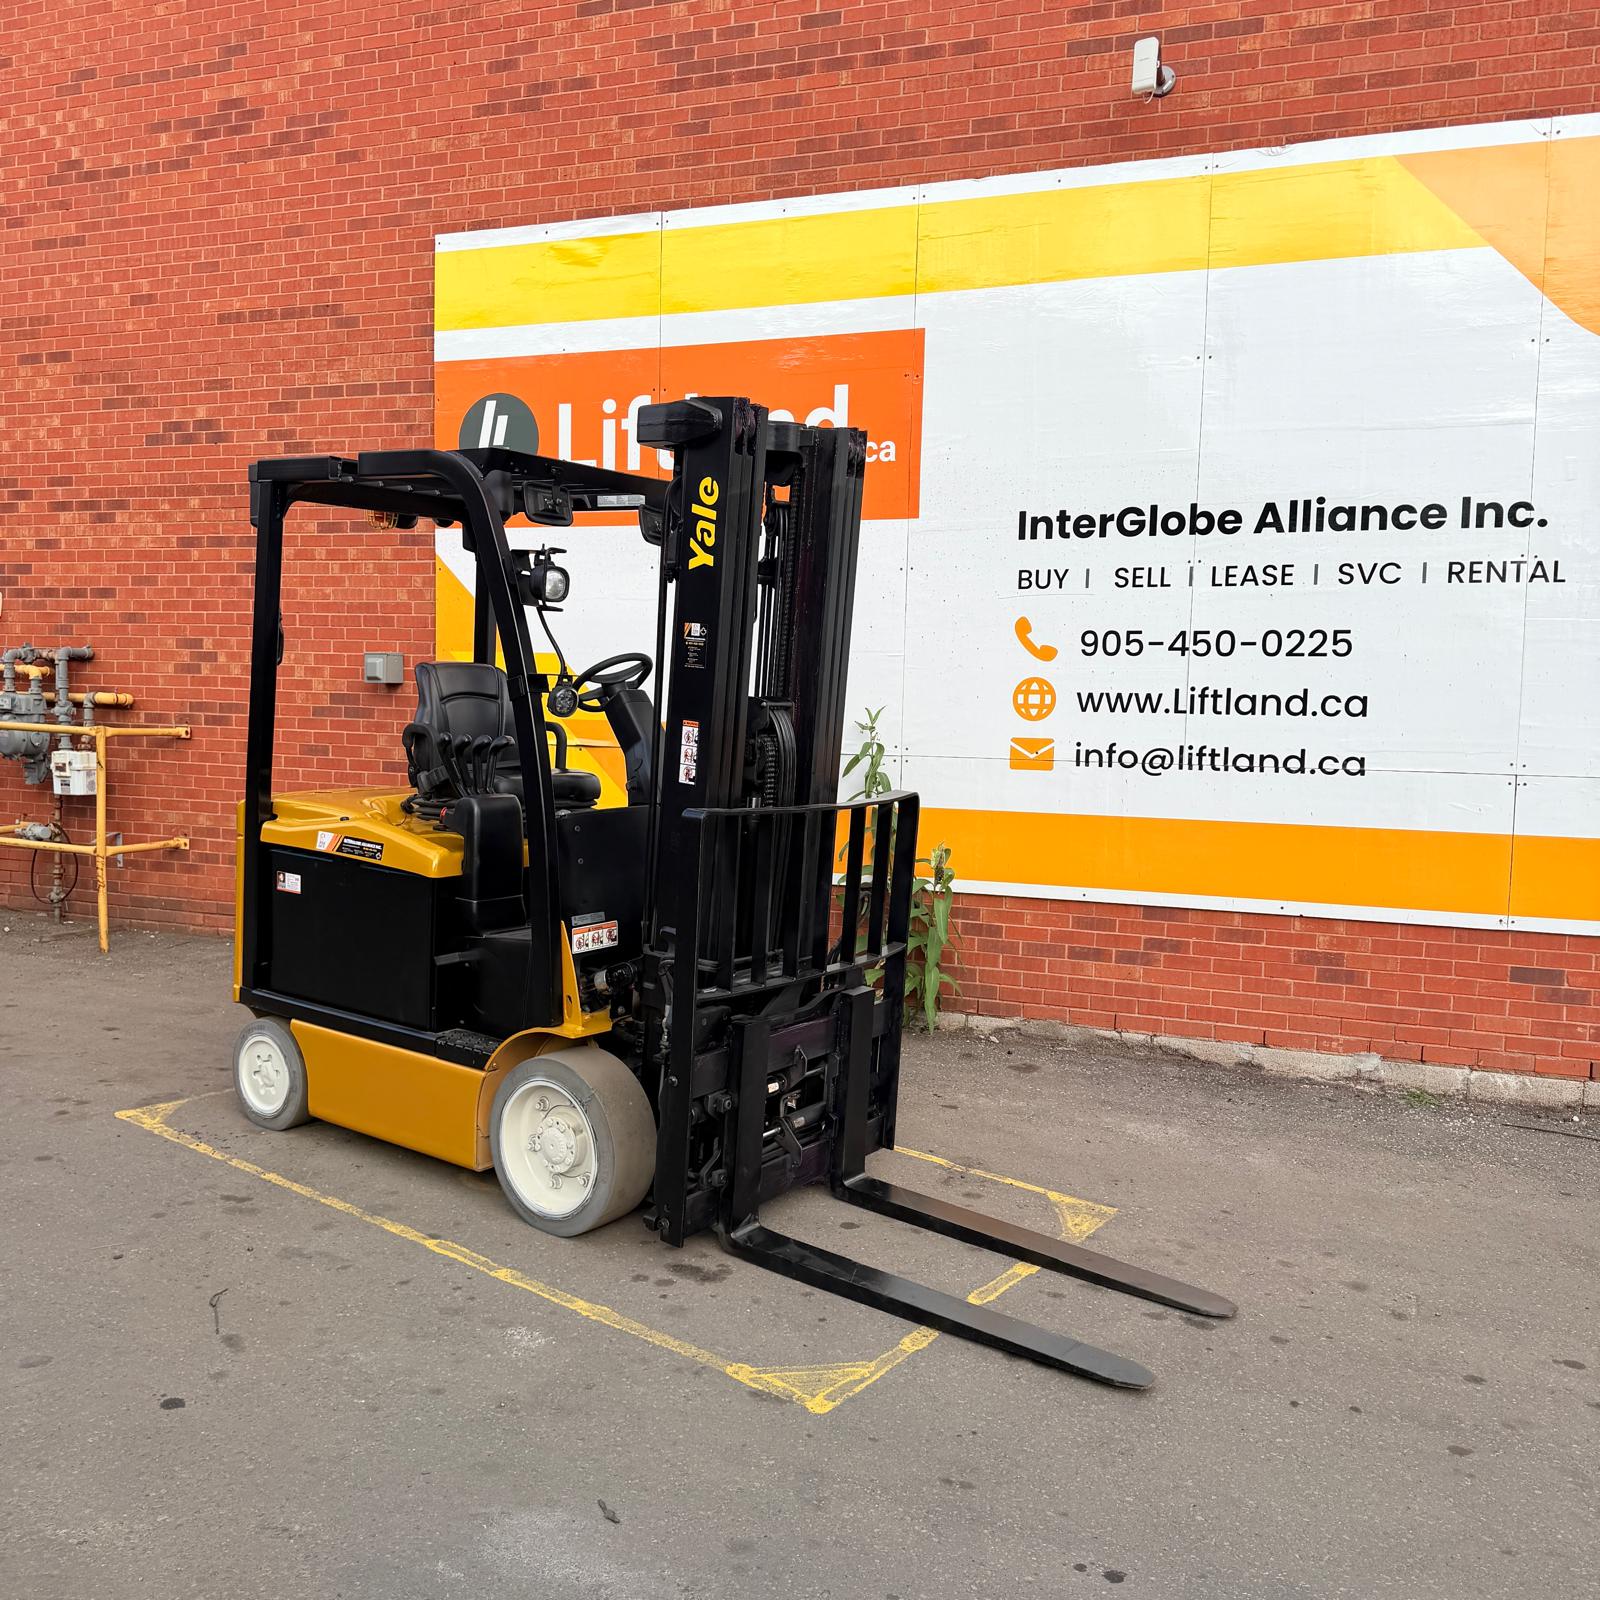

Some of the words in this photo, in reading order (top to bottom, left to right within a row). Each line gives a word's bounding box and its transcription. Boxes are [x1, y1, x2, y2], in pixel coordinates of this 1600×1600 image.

[688, 476, 719, 570] Yale
[1018, 502, 1243, 541] InterGlobe
[1253, 496, 1448, 534] Alliance
[1460, 496, 1548, 529] Inc.
[1017, 568, 1070, 590] BUY
[1114, 566, 1172, 589] SELL
[1211, 563, 1295, 587] LEASE
[1337, 562, 1402, 585] SVC
[1447, 560, 1566, 584] RENTAL
[1080, 629, 1353, 658] 905-450-0225
[1076, 686, 1368, 718] www.Liftland.ca
[1075, 741, 1366, 777] info@liftland.ca
